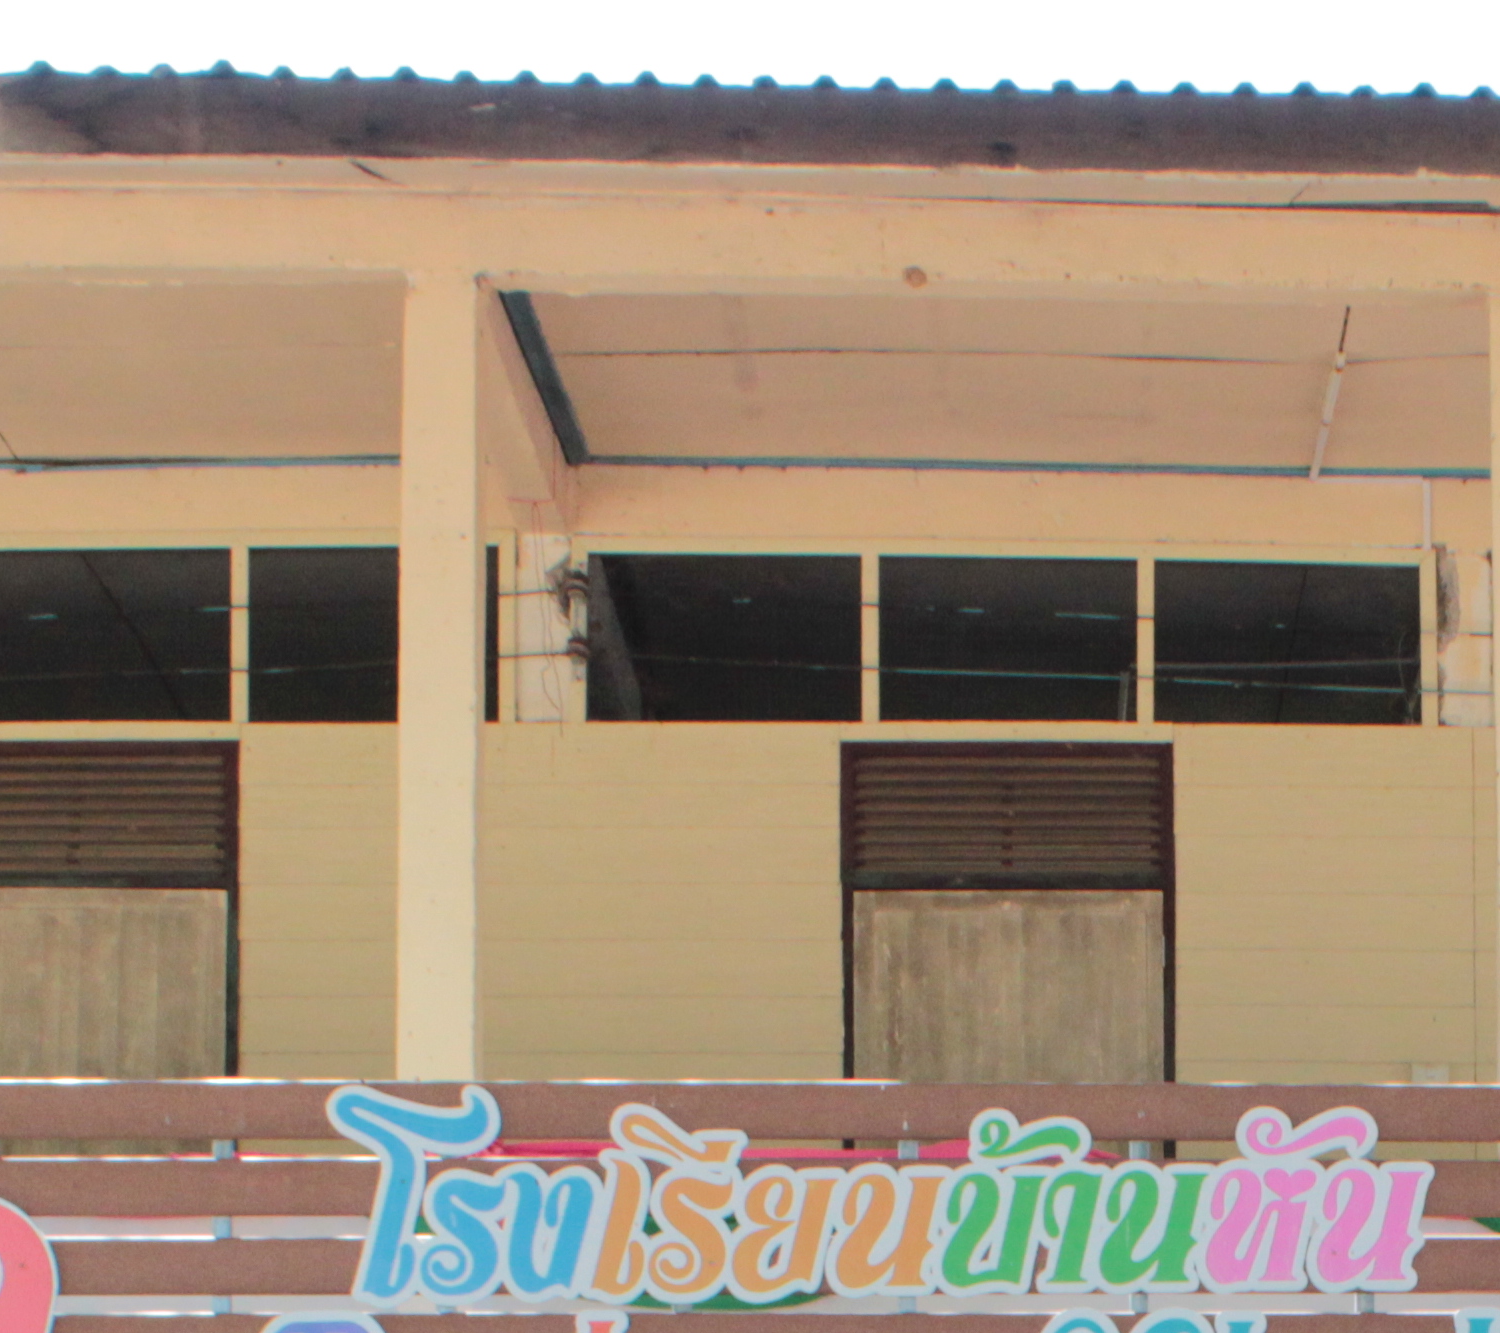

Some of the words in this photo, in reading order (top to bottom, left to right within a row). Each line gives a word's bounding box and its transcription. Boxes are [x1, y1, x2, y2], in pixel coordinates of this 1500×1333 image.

[333, 1090, 1426, 1300] โรงเรียนบ้านหัน
